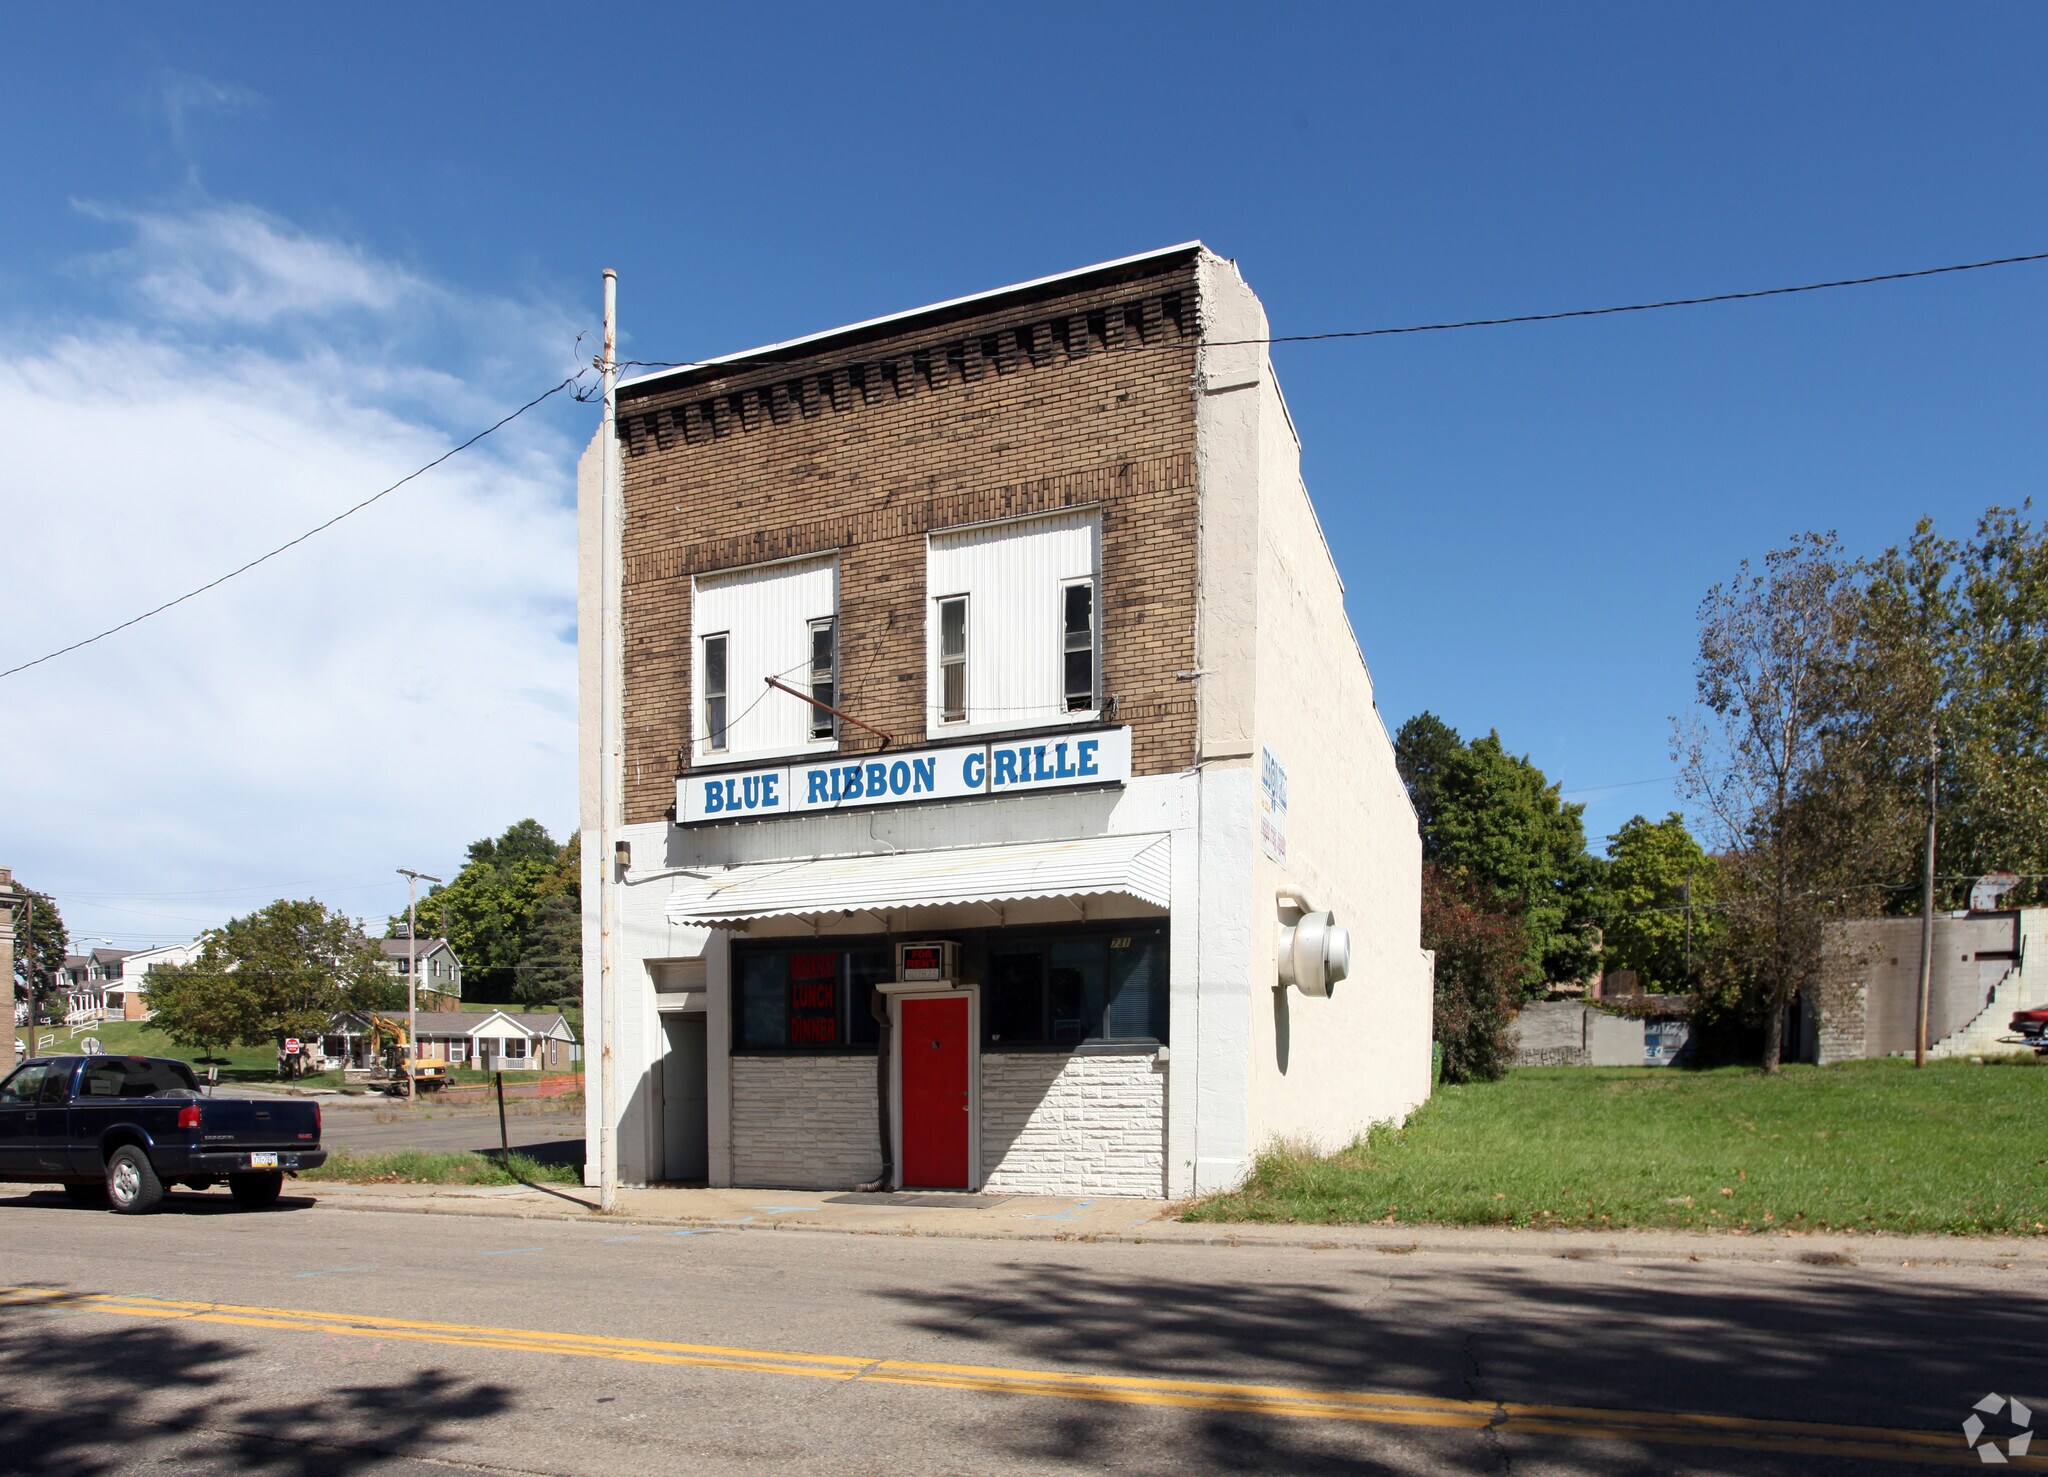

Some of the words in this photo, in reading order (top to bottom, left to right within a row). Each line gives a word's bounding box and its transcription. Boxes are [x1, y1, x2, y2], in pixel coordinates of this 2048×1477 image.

[705, 773, 779, 814] BLUE
[808, 756, 936, 804] RIBBON
[963, 739, 1099, 789] GRILLE
[1110, 936, 1132, 949] 731
[911, 949, 933, 959] FOR
[906, 959, 937, 969] RENT
[792, 983, 834, 1009] LUNCH
[791, 1016, 836, 1042] DINNER
[424, 1068, 435, 1076] CAT
